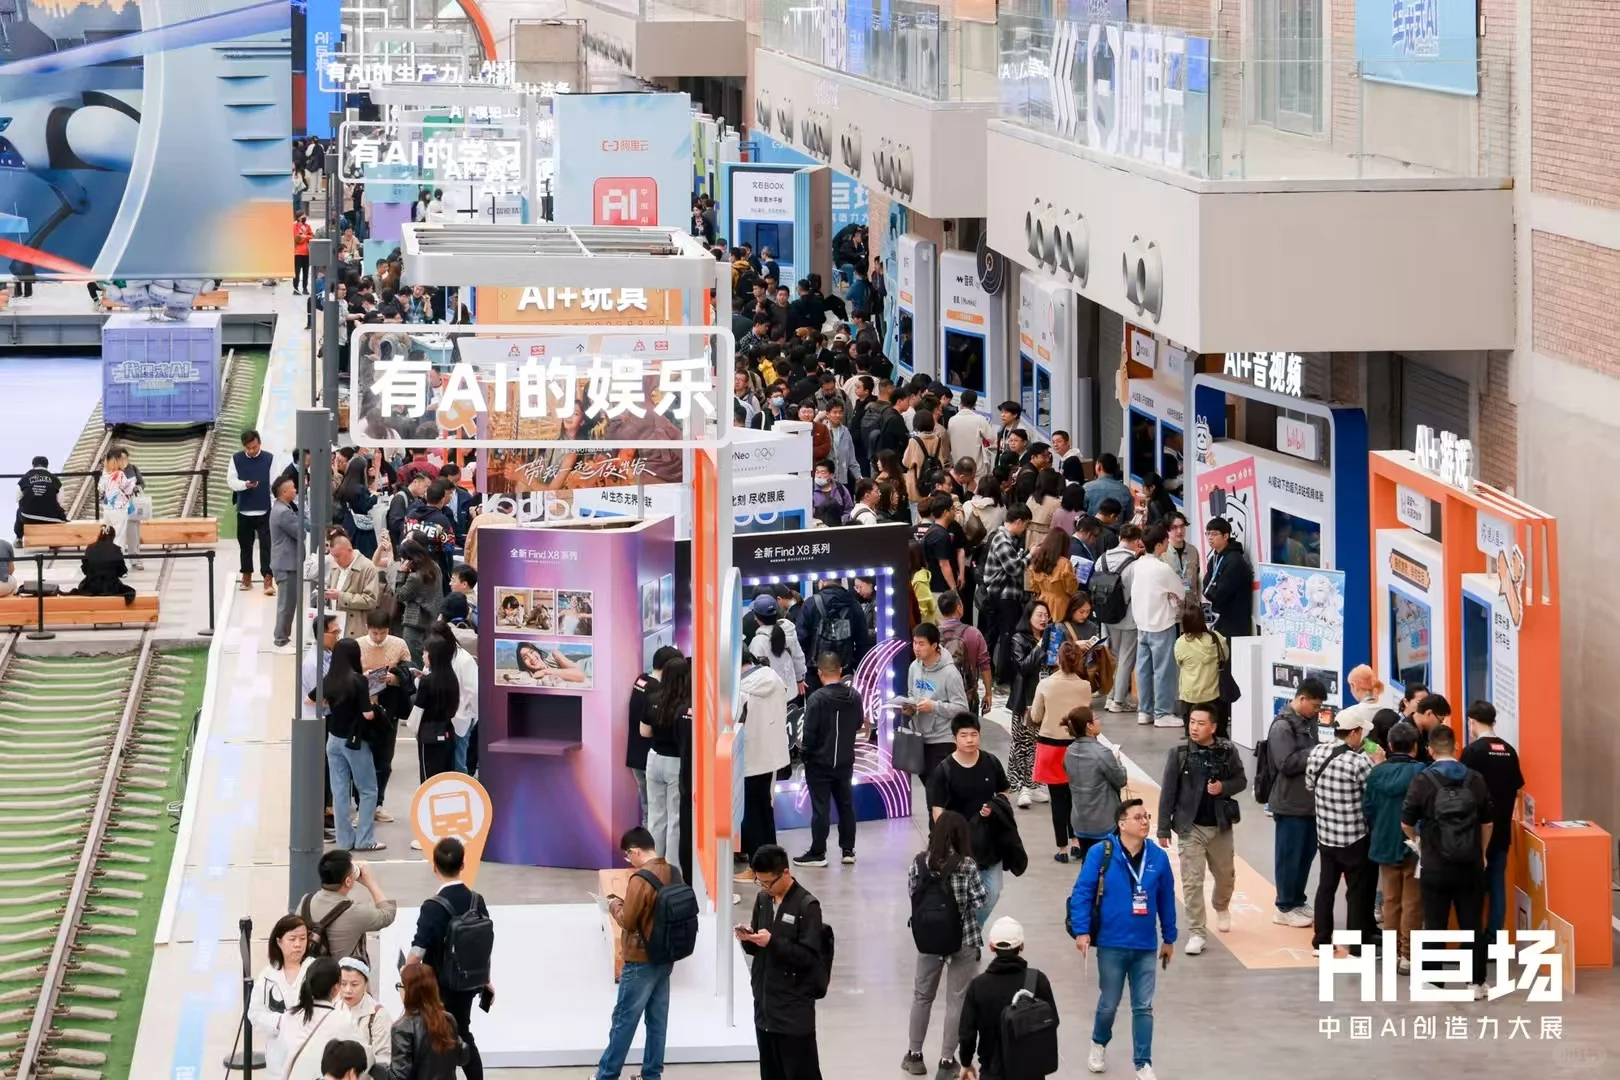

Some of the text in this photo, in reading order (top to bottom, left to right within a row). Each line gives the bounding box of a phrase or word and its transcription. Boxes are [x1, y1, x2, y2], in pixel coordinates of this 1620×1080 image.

[327, 61, 459, 84] 有AI的生产力
[350, 136, 521, 170] 有AI的学习
[620, 140, 649, 152] 阿里云
[752, 181, 784, 190] 文石BOOX
[517, 287, 648, 313] AI+玩具
[1223, 352, 1303, 397] AI+音视频
[370, 355, 715, 420] 有AI的娱乐
[624, 493, 653, 508] 无界联
[748, 490, 785, 505] 尽收眼底
[510, 549, 578, 560] 全新 Find X8 系列
[754, 543, 831, 559] 全新 Find X8 系列
